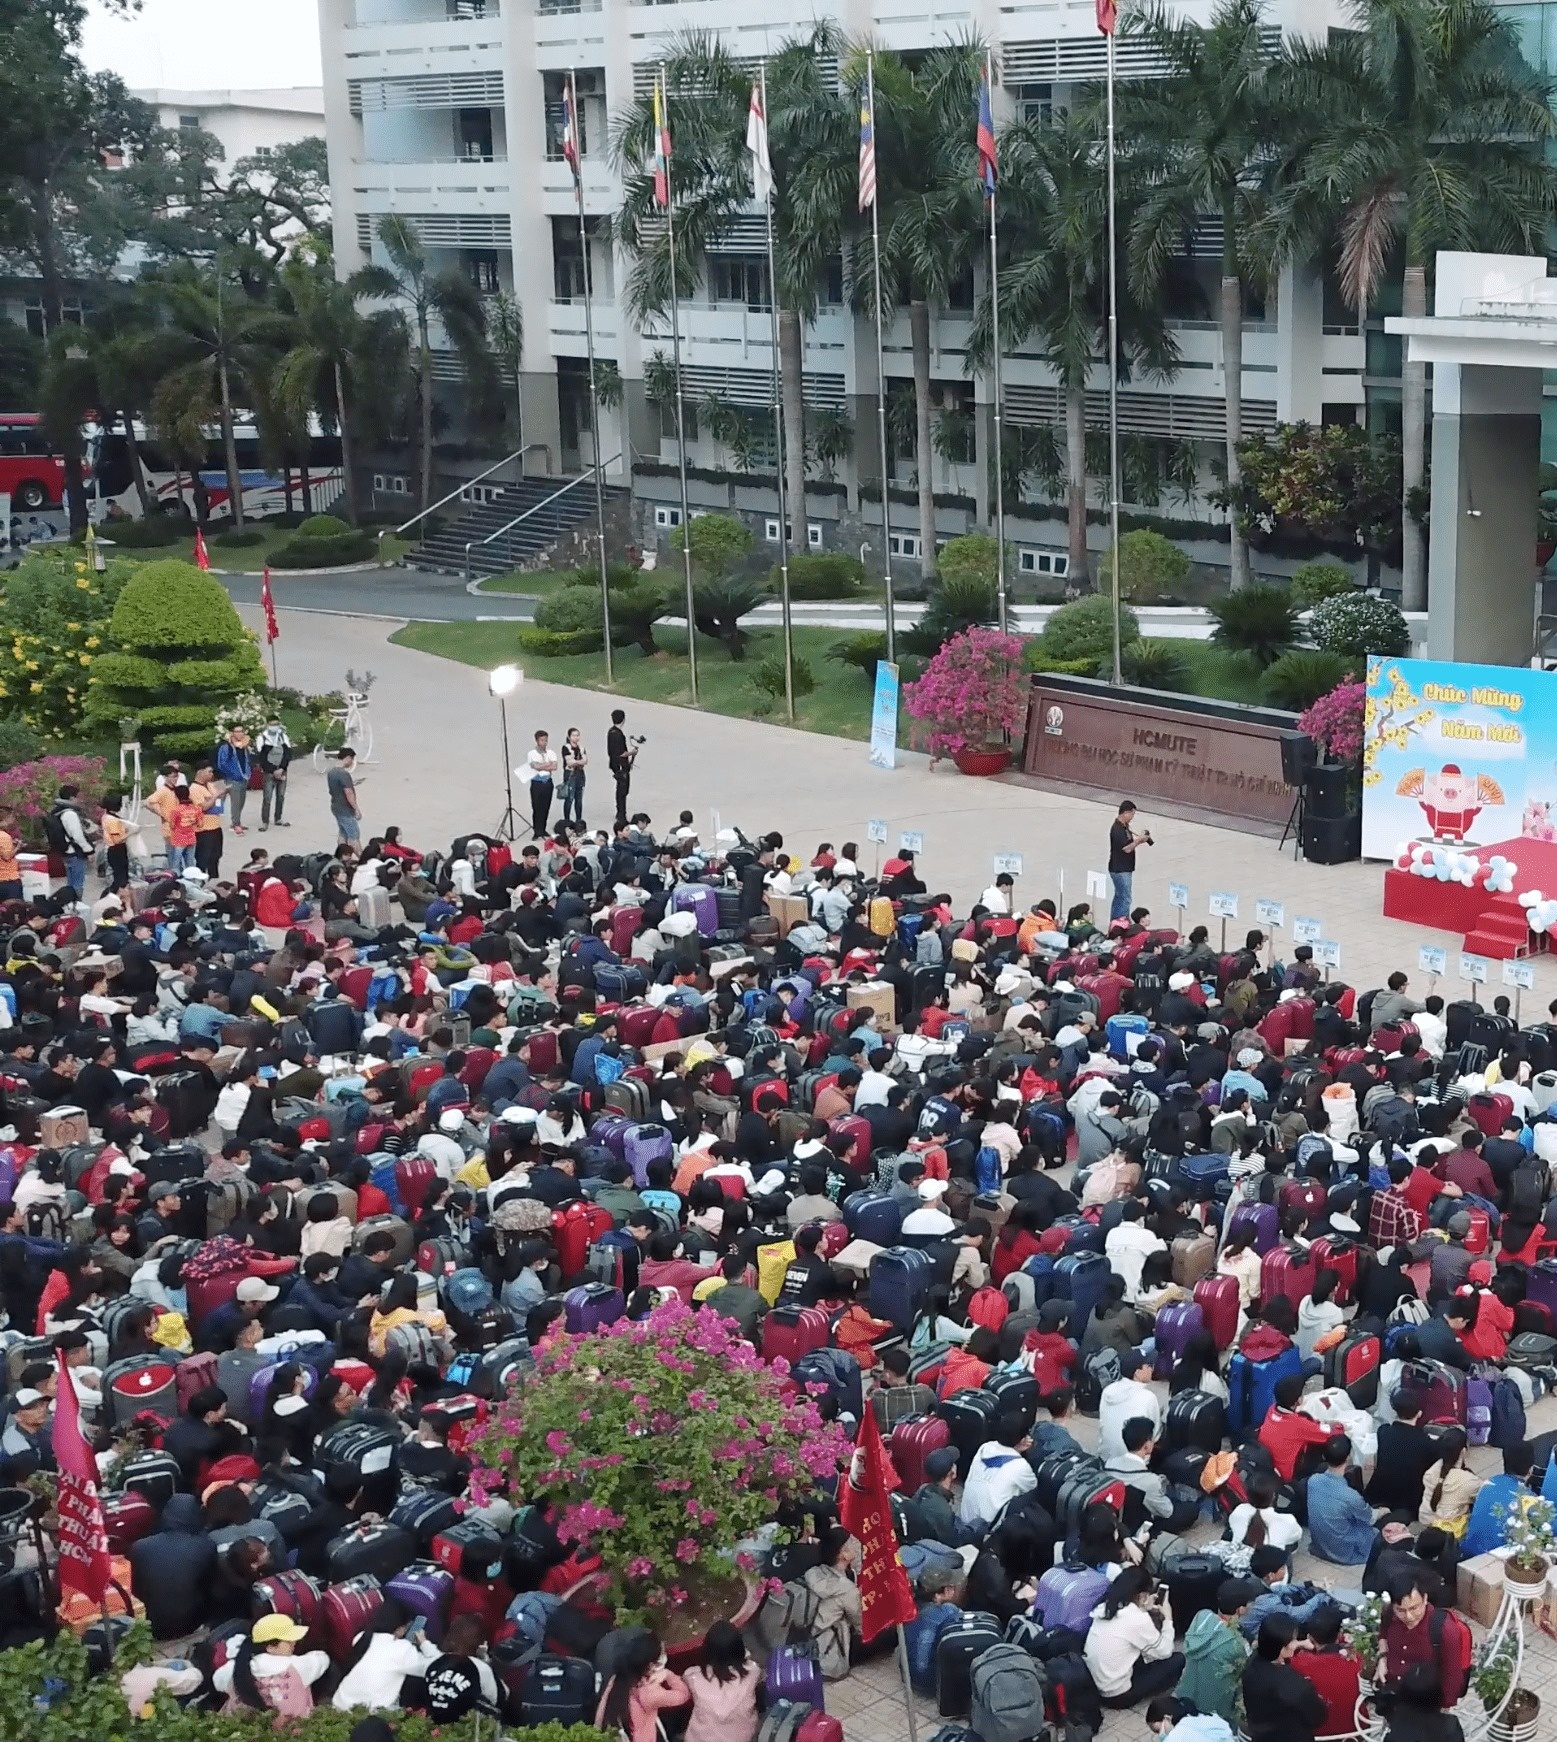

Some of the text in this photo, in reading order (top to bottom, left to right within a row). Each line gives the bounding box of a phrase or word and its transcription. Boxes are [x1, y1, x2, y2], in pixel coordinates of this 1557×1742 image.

[1423, 682, 1523, 713] Chúc Mừng
[1133, 728, 1197, 756] HCMUTE
[1441, 719, 1484, 740] Năm
